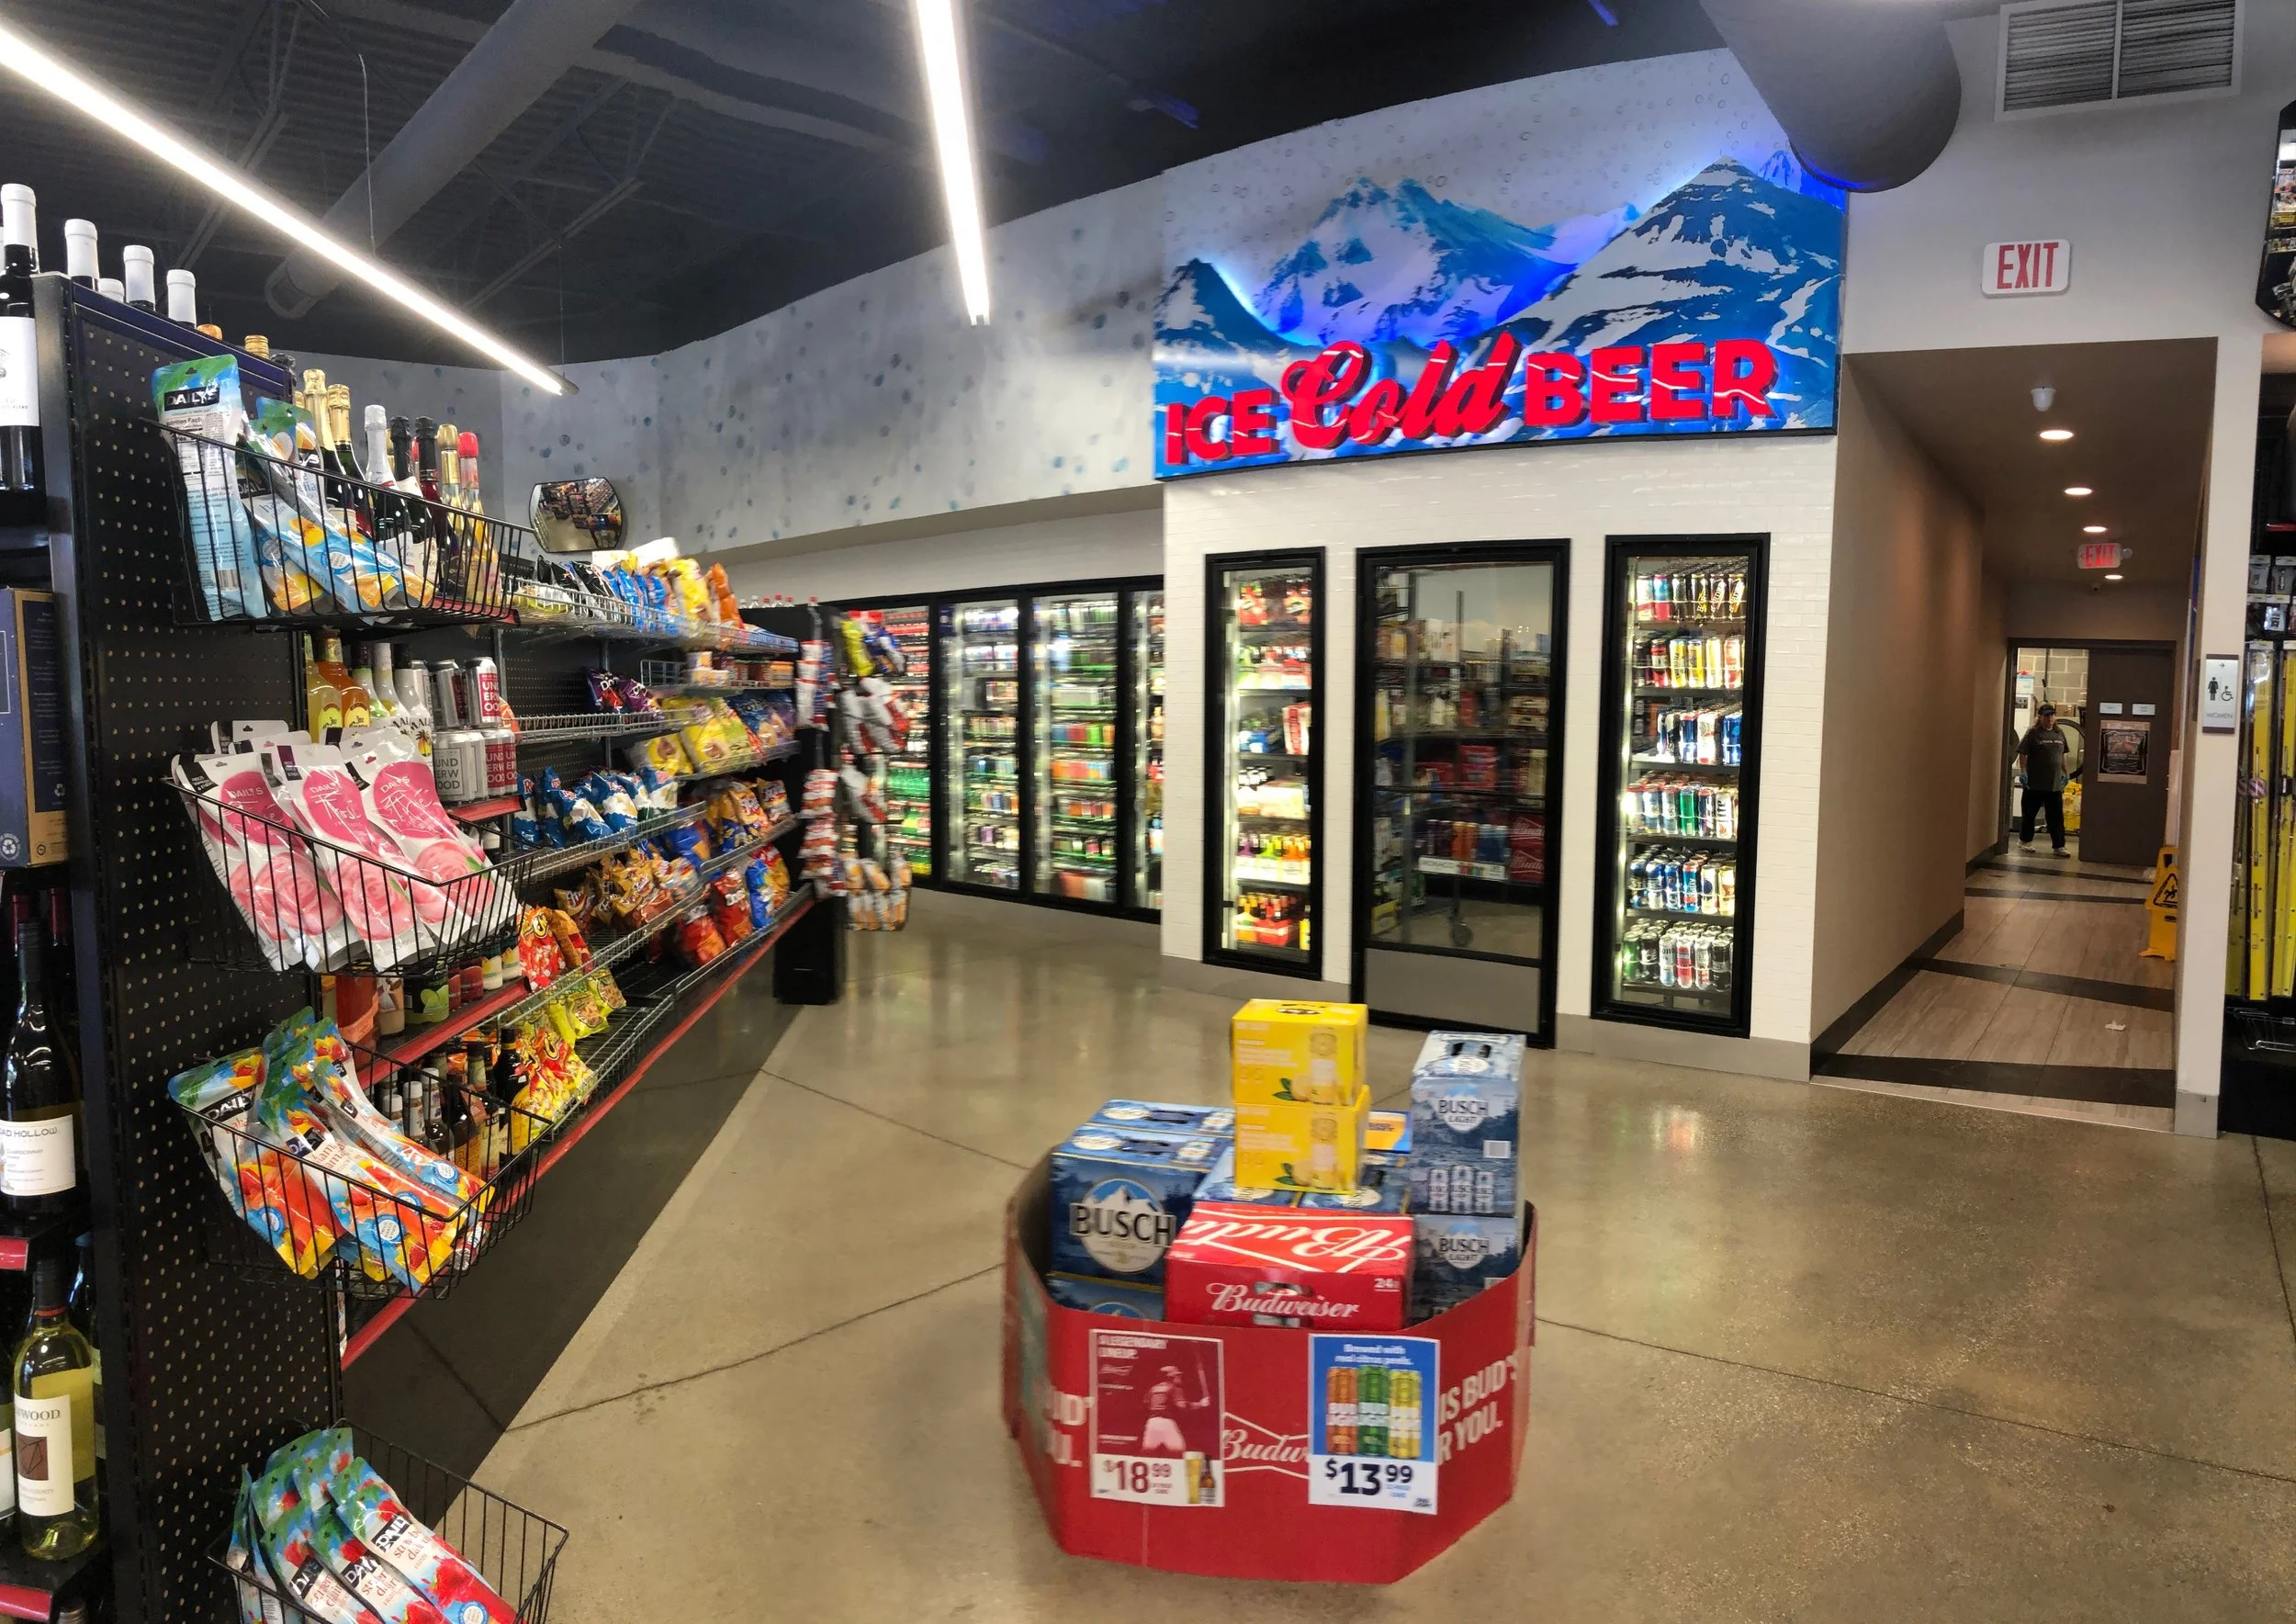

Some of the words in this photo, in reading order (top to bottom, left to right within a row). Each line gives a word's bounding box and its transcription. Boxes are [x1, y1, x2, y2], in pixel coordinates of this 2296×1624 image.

[1997, 242, 2059, 289] EXIT
[1165, 389, 1280, 467] ICE
[1281, 332, 1523, 451] Cold
[1525, 339, 1779, 428] BEER
[2085, 544, 2116, 567] EXIT
[1438, 1100, 1490, 1117] BUSCH
[15, 1126, 58, 1138] HOLLOW
[1072, 1203, 1176, 1248] BUSCH
[1438, 1237, 1490, 1254] BUSCH
[1206, 1282, 1360, 1318] Budweiser
[1439, 1386, 1461, 1426] IS
[1454, 1400, 1503, 1452] YOU.
